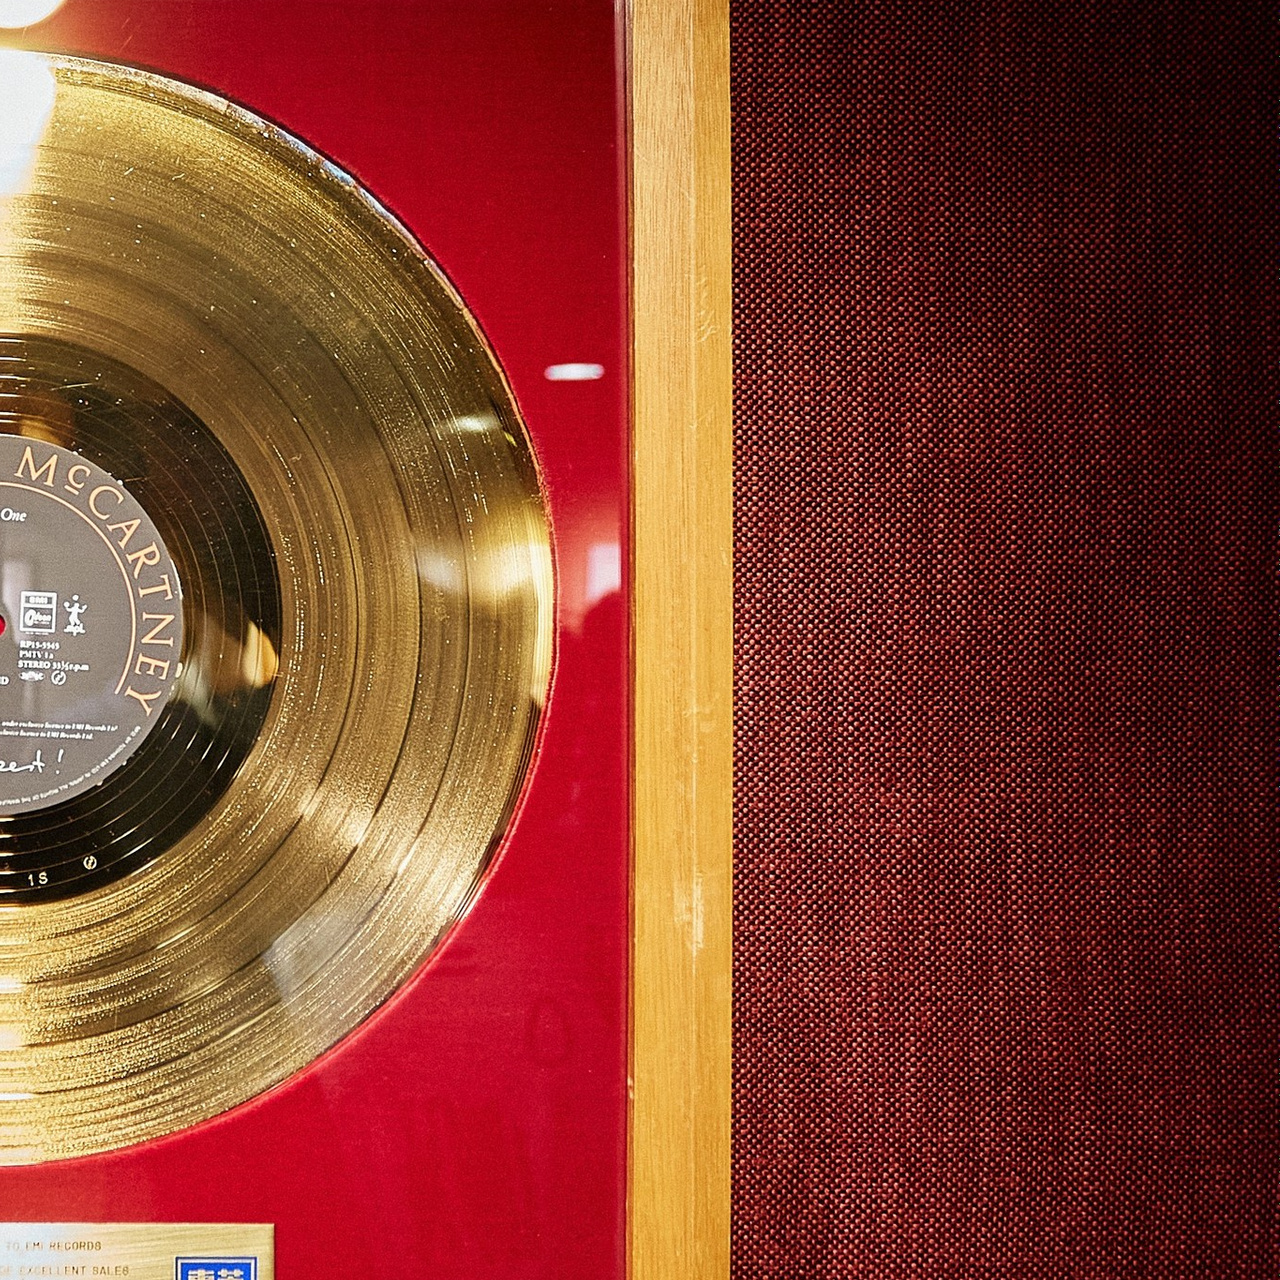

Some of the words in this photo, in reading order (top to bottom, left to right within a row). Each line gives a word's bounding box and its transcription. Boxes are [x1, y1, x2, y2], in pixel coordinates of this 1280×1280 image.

[1, 508, 27, 522] One
[18, 660, 51, 669] STEREO
[25, 1241, 44, 1252] EMI
[49, 1241, 102, 1252] RECORDS
[19, 1265, 86, 1276] EXCELLENT
[92, 1265, 130, 1276] SALES
